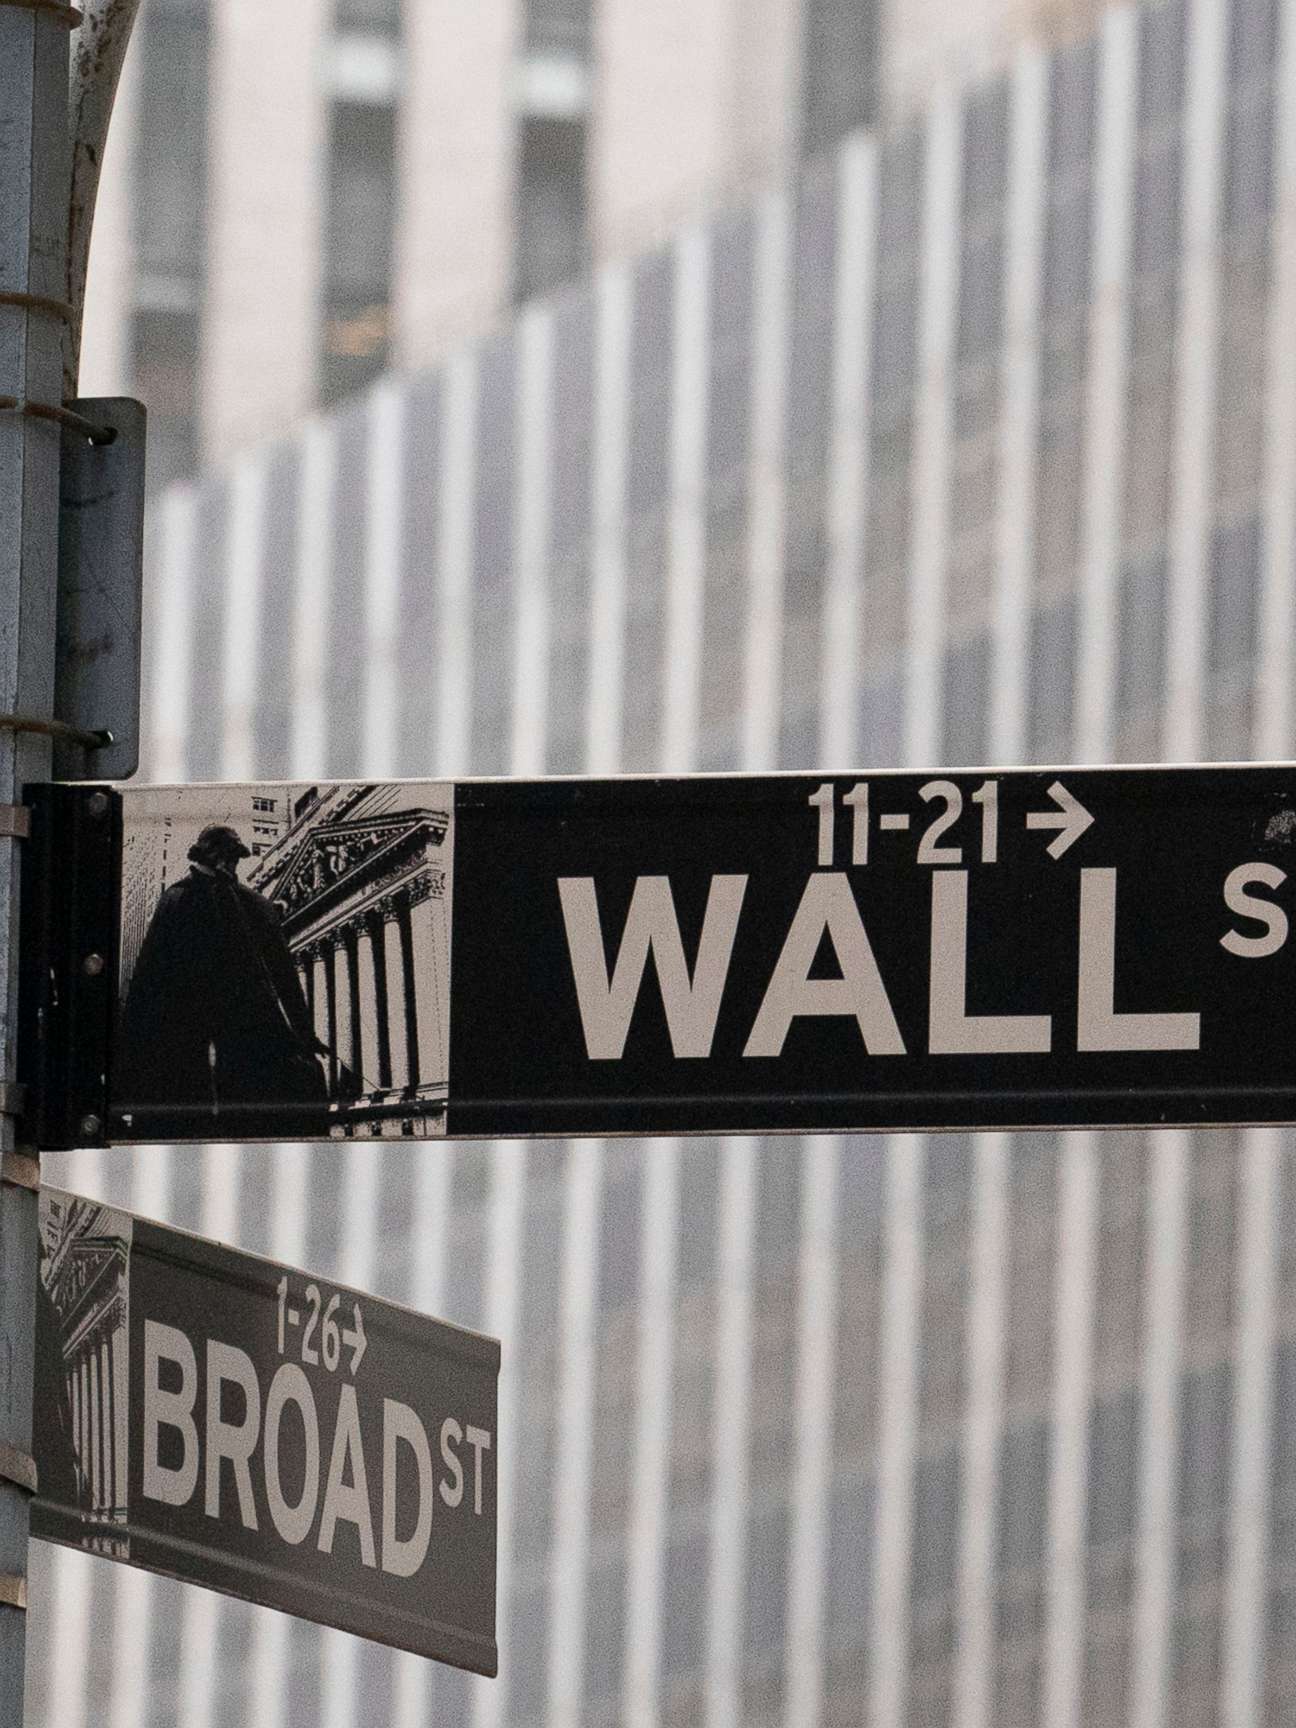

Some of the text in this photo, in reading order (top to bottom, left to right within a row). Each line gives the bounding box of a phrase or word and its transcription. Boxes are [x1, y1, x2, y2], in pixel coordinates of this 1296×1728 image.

[808, 780, 999, 867] 11-21
[557, 867, 1201, 1060] WALL
[275, 1276, 341, 1373] 1-26
[142, 1319, 492, 1578] BROAD ST
